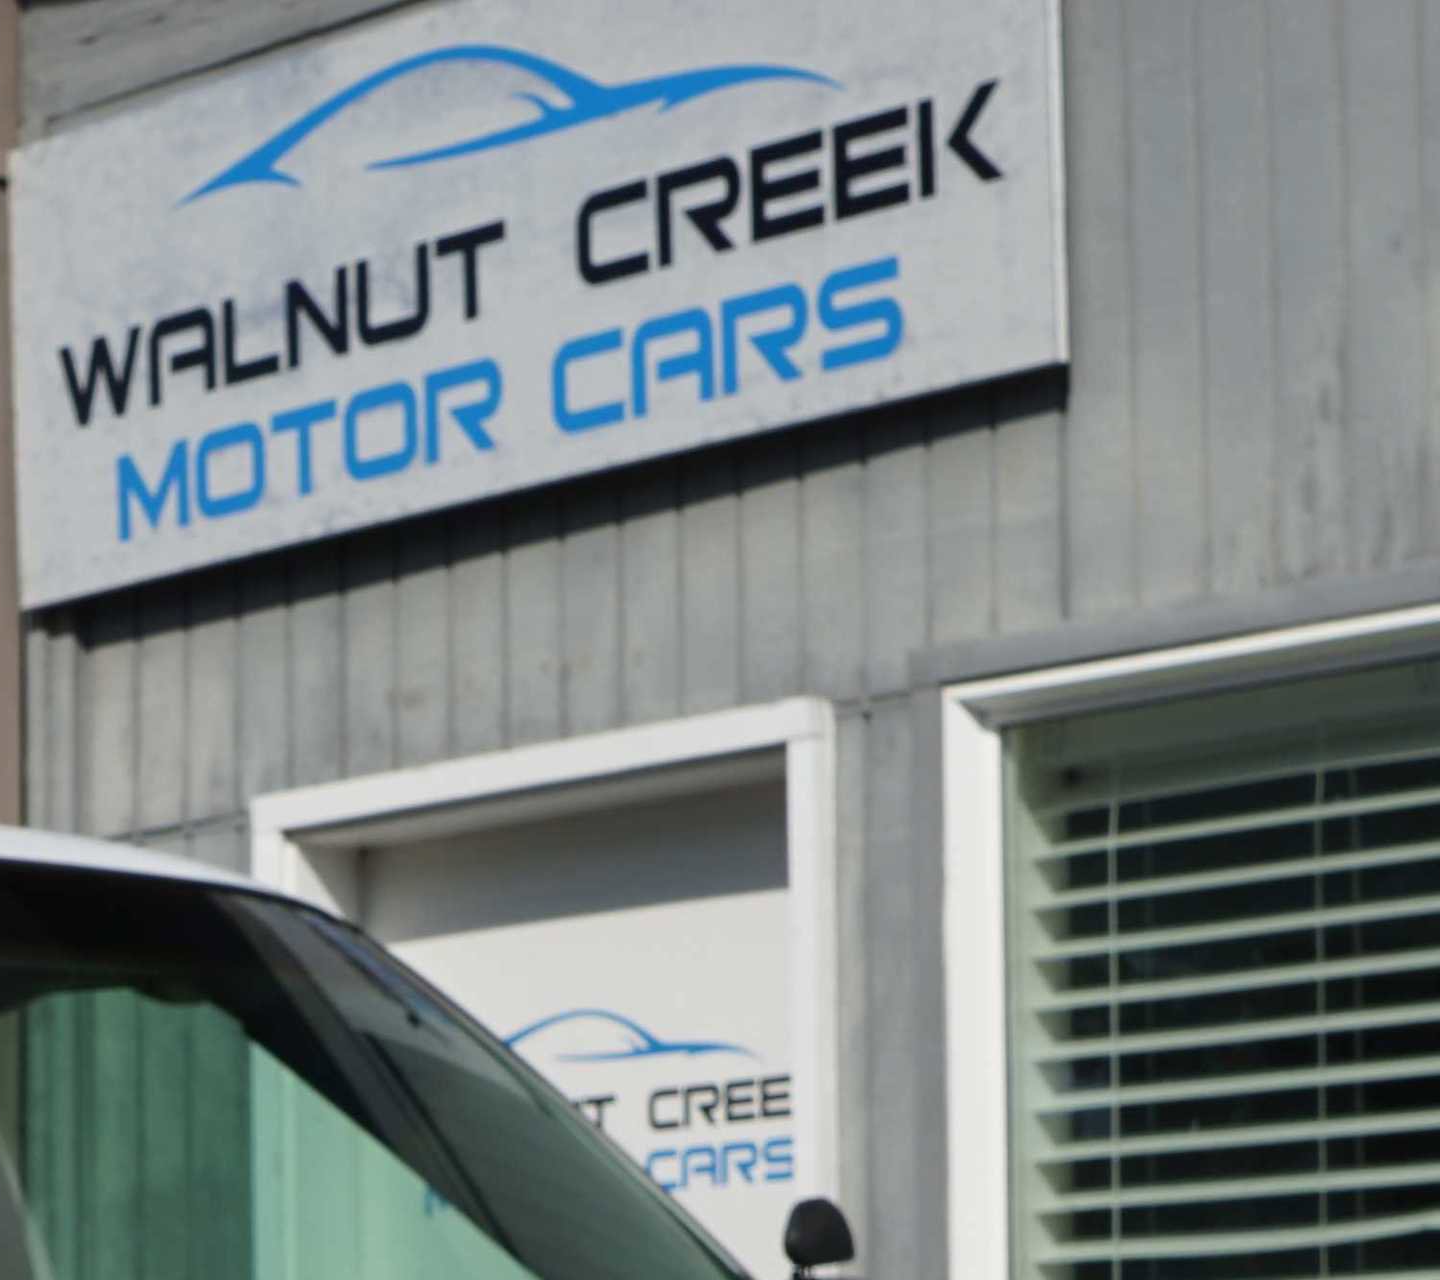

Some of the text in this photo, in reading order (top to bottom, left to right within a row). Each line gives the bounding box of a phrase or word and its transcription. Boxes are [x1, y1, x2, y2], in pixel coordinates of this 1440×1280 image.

[60, 81, 1004, 426] WALNUT CREEK
[116, 255, 906, 544] MOTOR CARS
[644, 1136, 795, 1194] CARS
